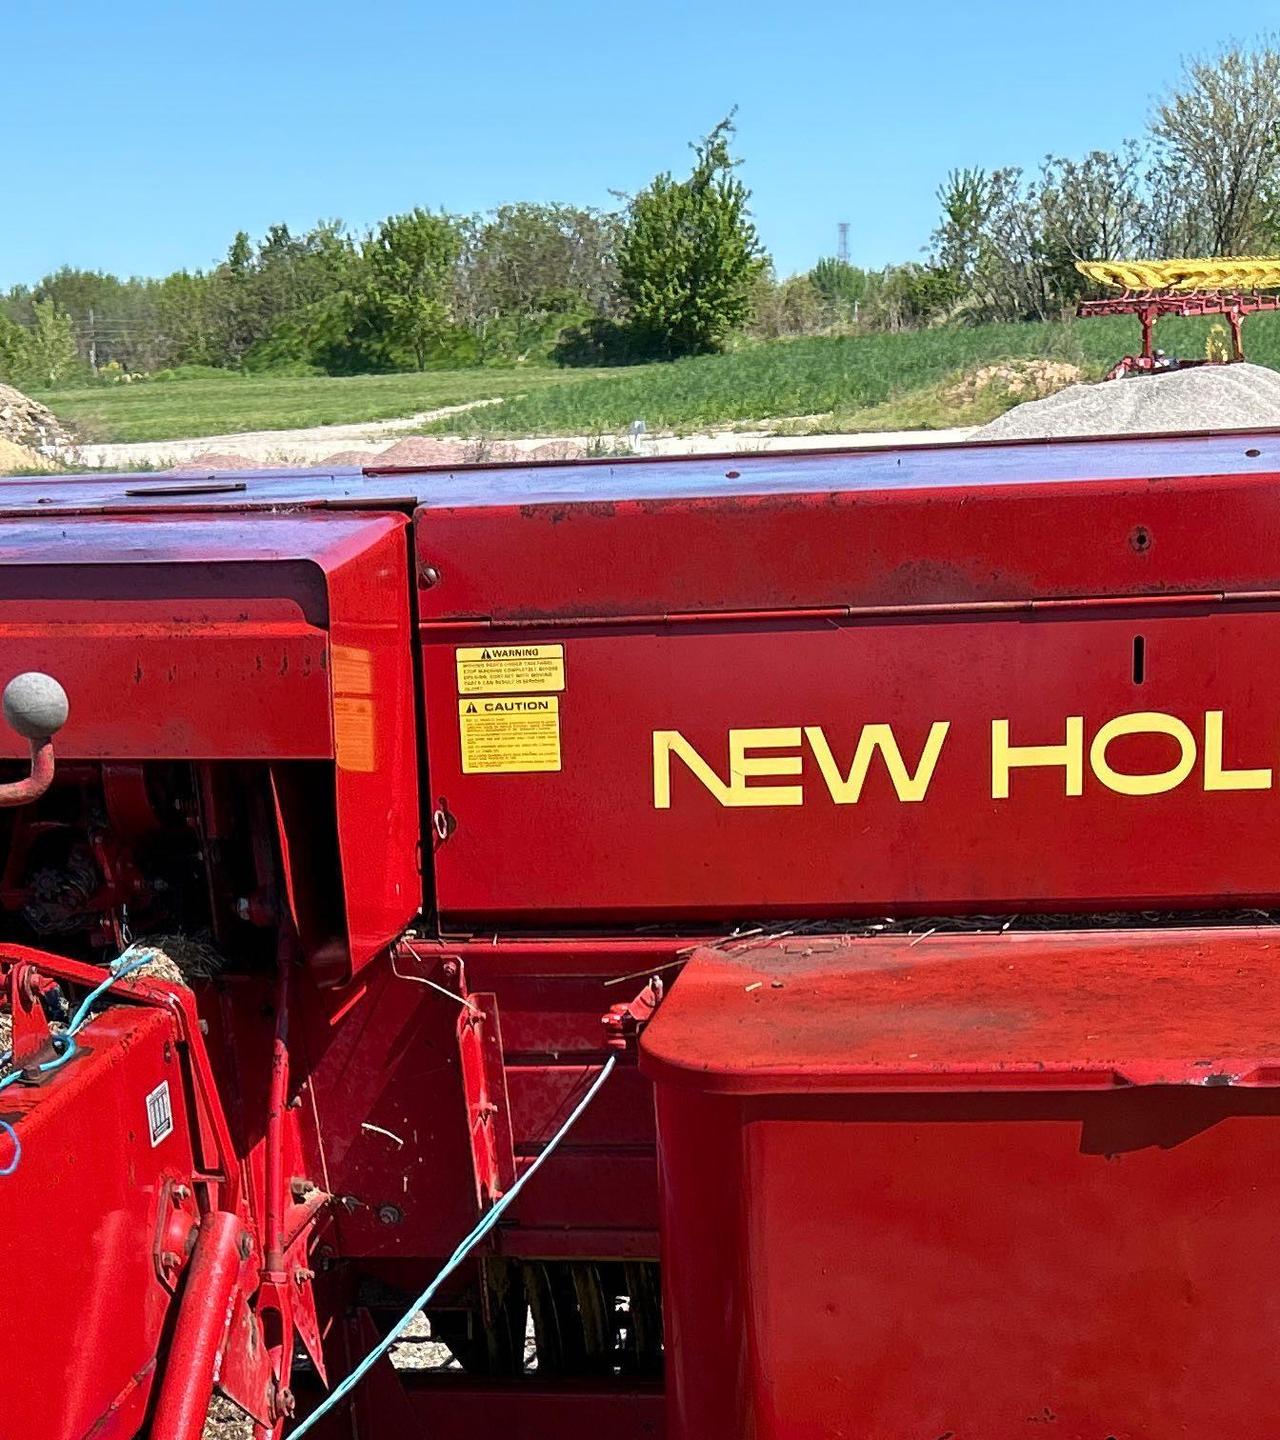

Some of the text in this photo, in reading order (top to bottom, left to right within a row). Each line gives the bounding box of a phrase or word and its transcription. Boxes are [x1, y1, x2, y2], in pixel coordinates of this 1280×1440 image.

[491, 648, 539, 658] WARNING
[484, 701, 548, 711] CAUTION
[652, 721, 950, 808] NEW
